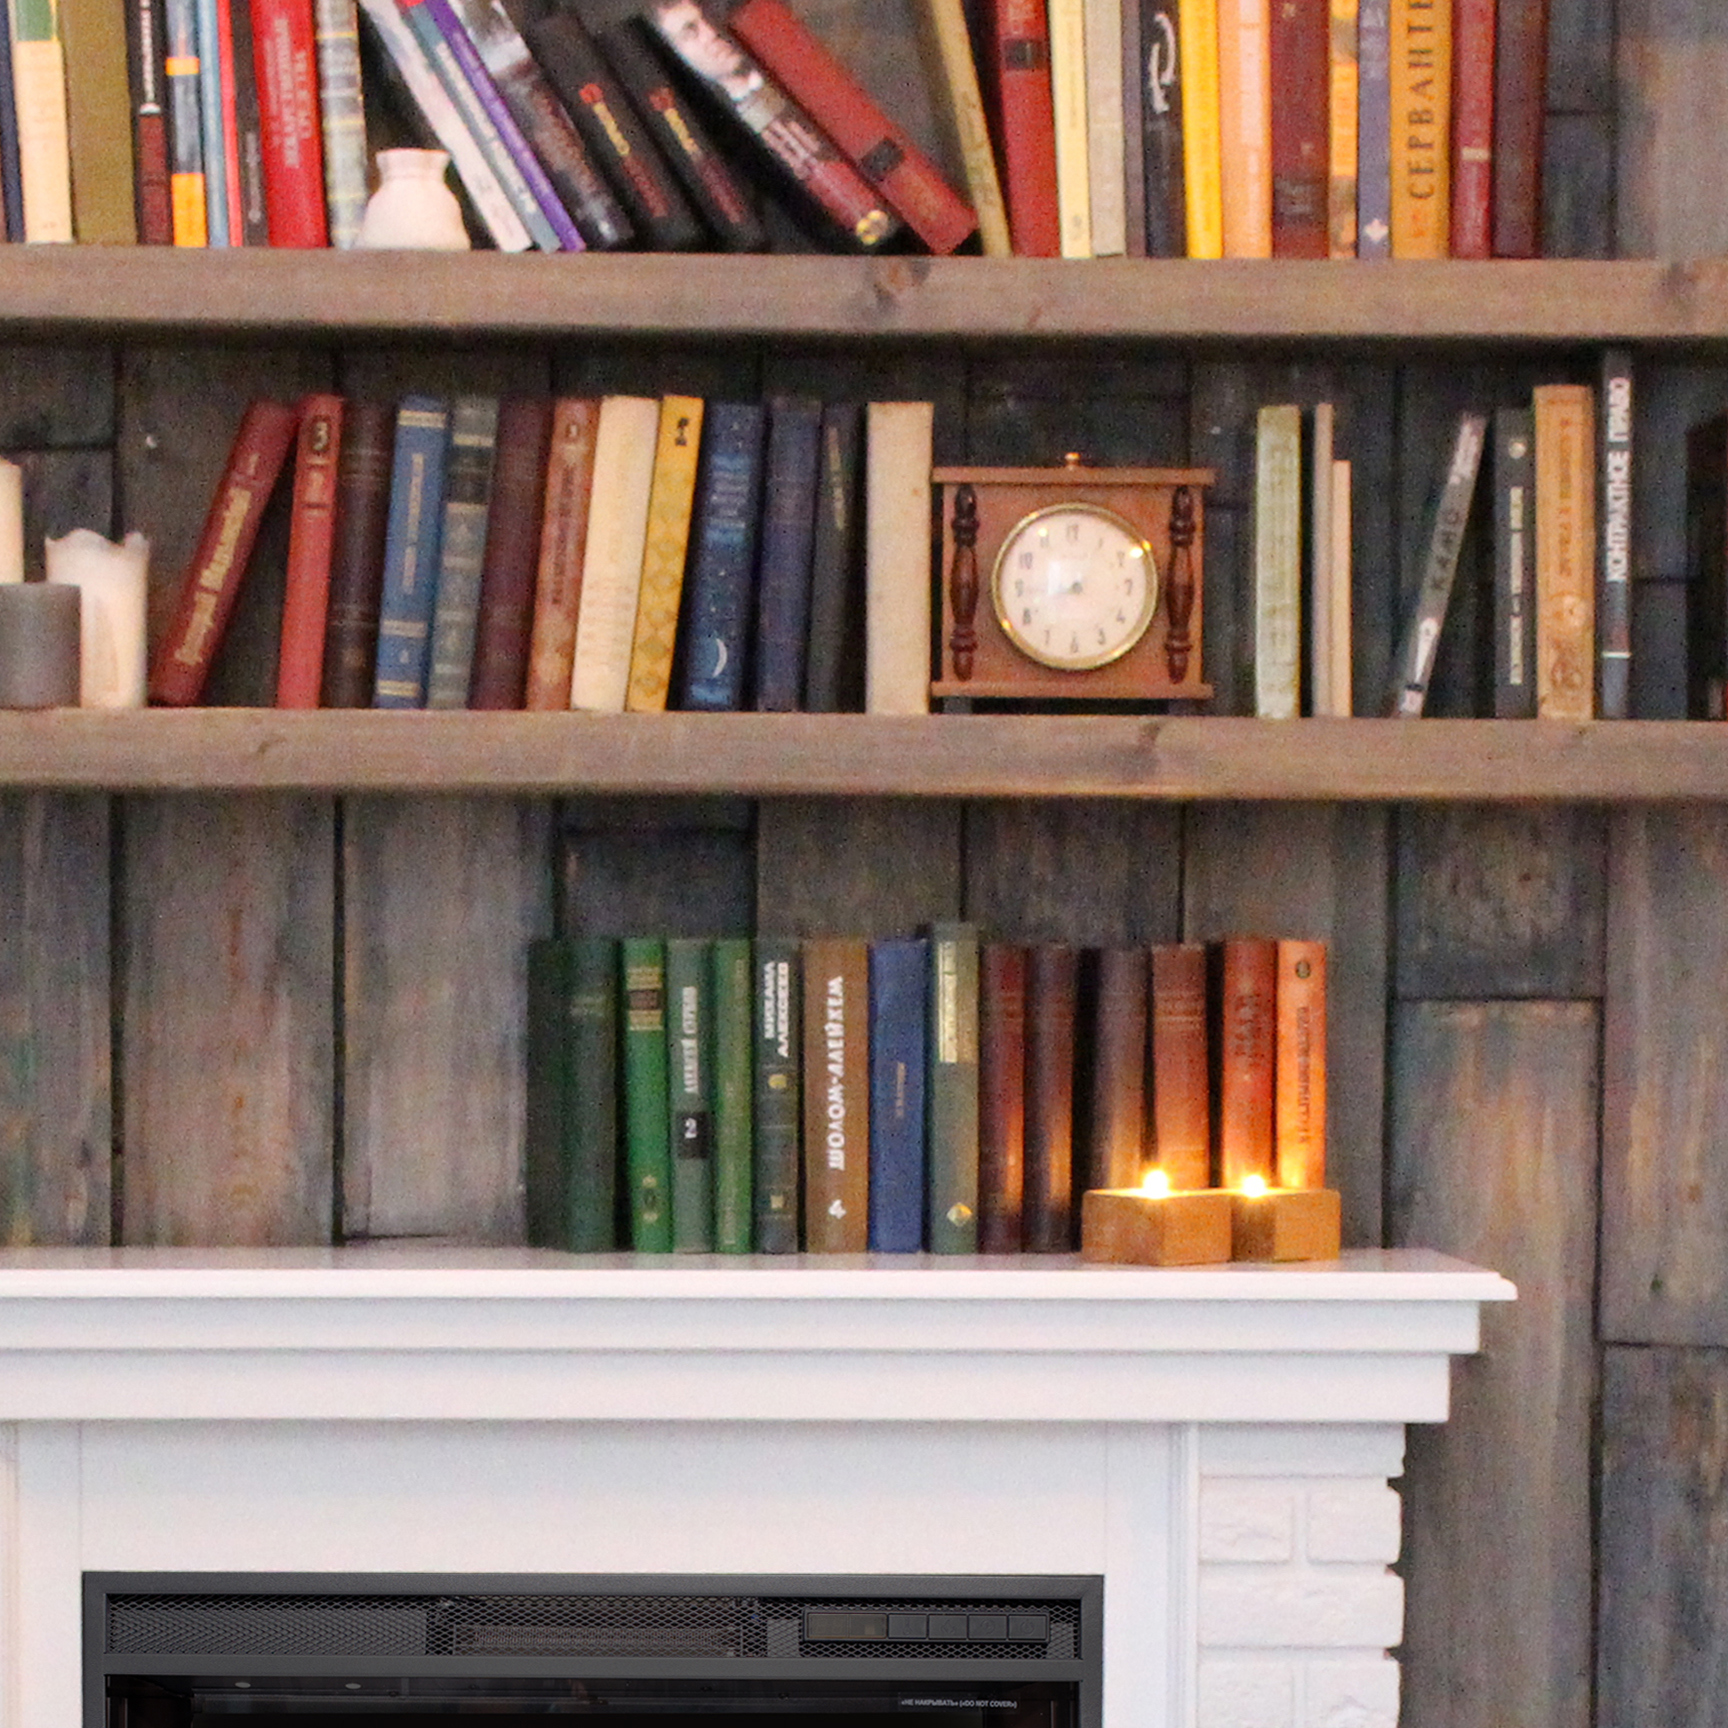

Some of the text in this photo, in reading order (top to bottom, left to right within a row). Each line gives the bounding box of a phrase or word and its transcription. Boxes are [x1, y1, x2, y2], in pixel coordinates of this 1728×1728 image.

[1605, 377, 1630, 581] КОНТРАКТНОЕ ПРАВО
[764, 961, 775, 1038] МИХАИЛ
[777, 962, 788, 1057] АЛЕКСЕЕВ
[825, 975, 845, 1170] ШОЛОМ-АЛЕЙХЕМ
[684, 1117, 697, 1138] 2
[828, 1199, 846, 1218] 4
[975, 1699, 988, 1707] NOT
